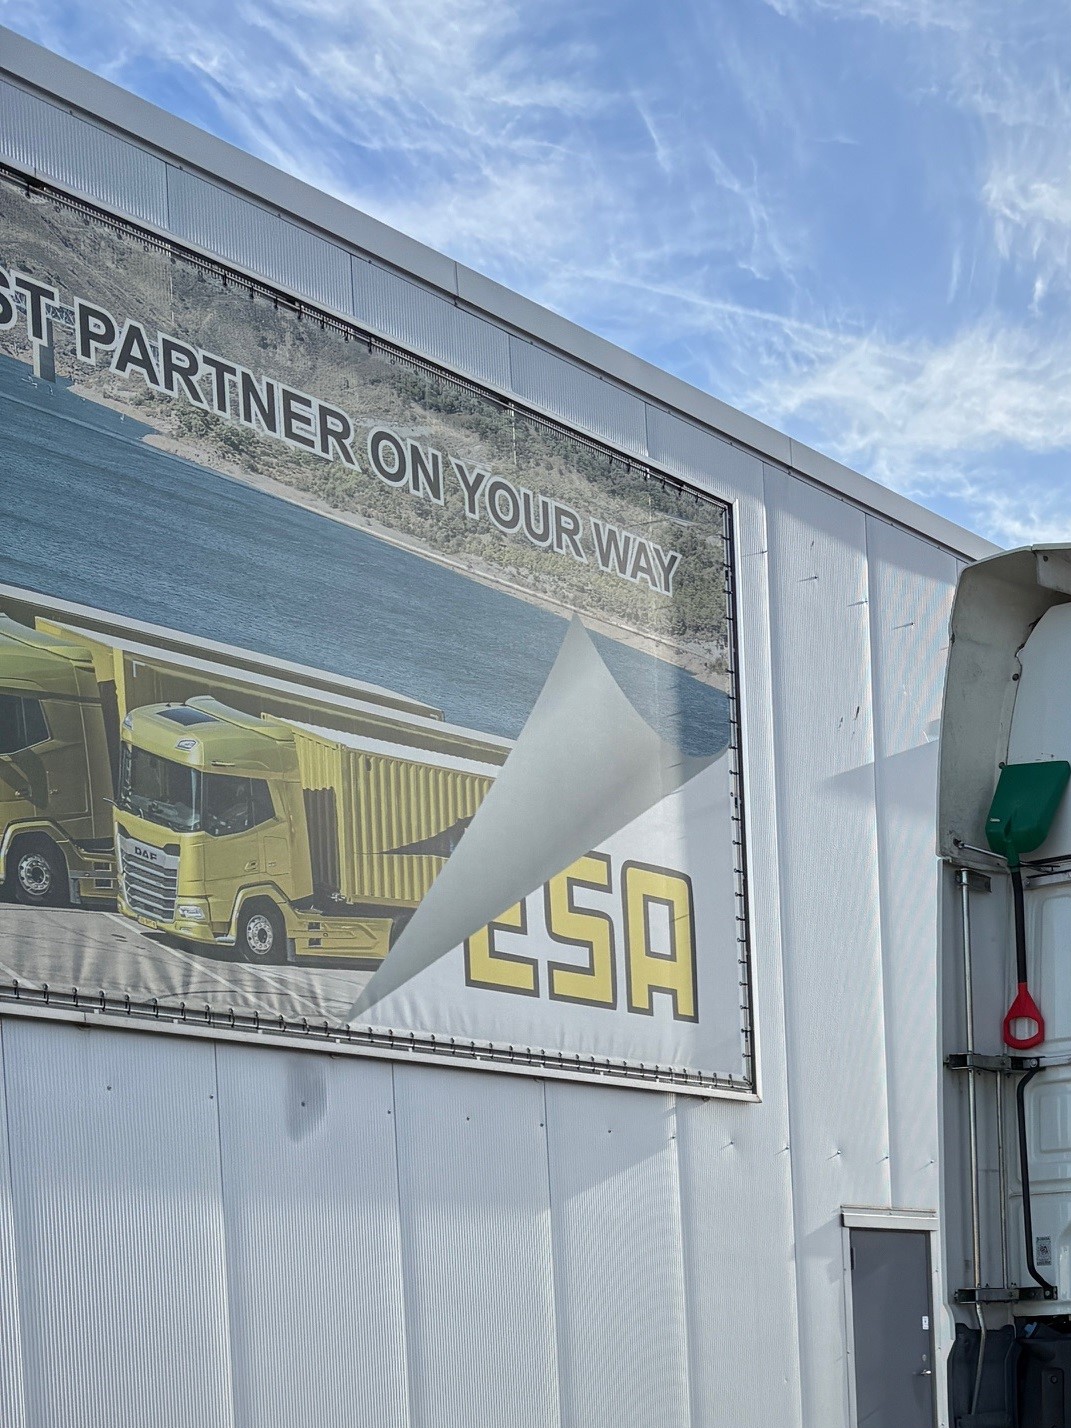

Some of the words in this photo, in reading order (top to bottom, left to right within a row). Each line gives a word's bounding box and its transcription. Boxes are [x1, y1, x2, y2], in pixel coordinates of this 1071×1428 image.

[74, 296, 362, 472] PARTNER
[367, 426, 444, 506] ON
[450, 457, 589, 564] YOUR
[590, 517, 682, 597] WAY
[134, 846, 157, 861] DAF
